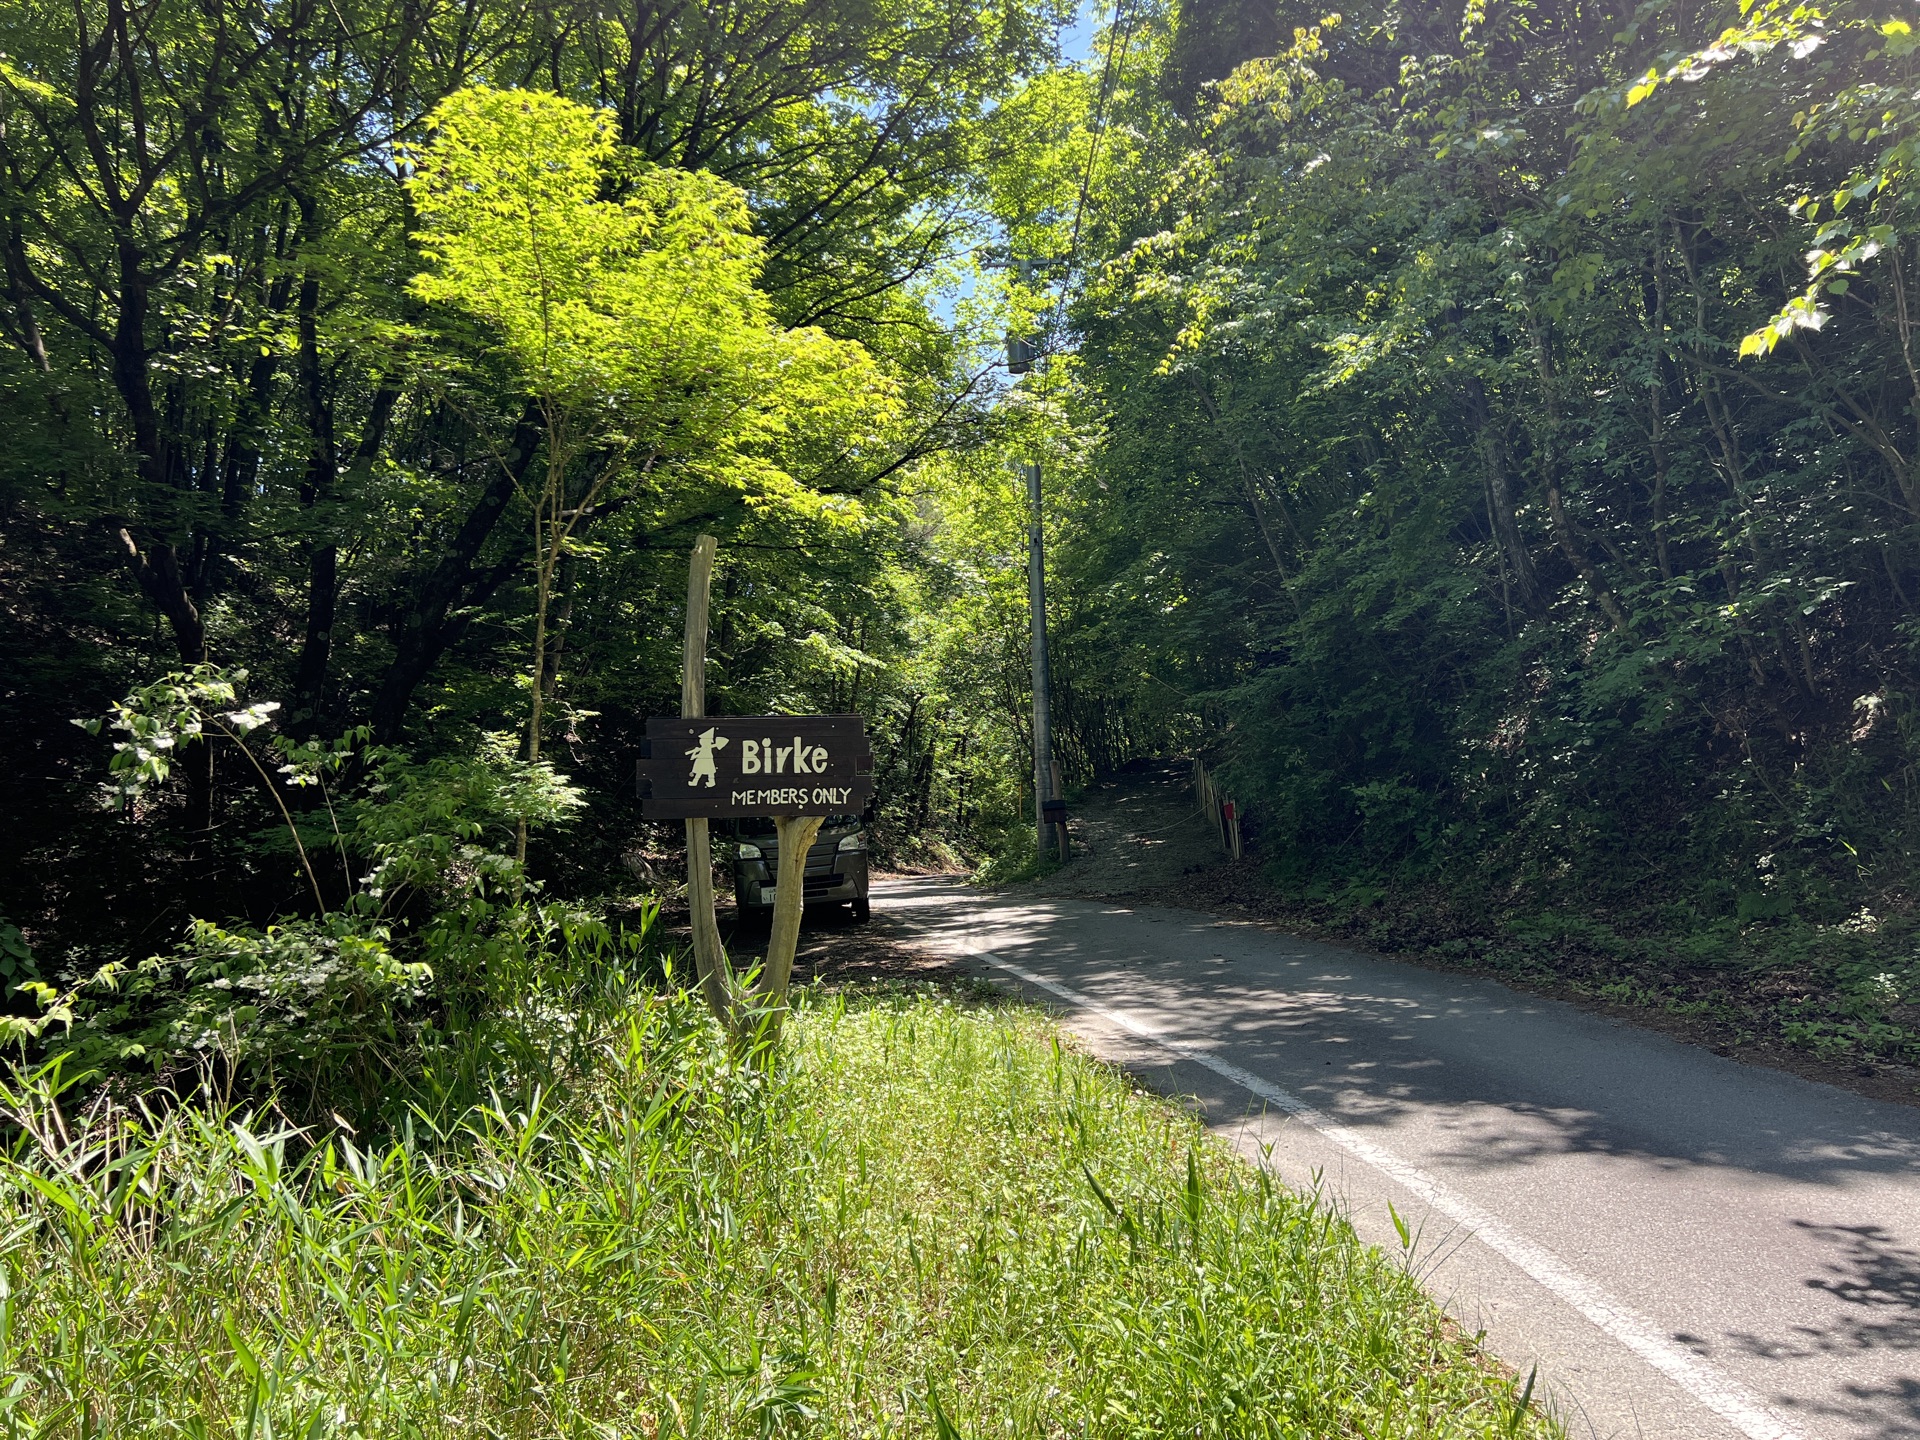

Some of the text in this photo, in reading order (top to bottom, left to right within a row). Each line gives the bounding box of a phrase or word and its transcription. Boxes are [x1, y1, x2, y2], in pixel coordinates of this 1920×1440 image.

[742, 736, 828, 774] Birke
[731, 787, 852, 805] MEMBERS ONLY
